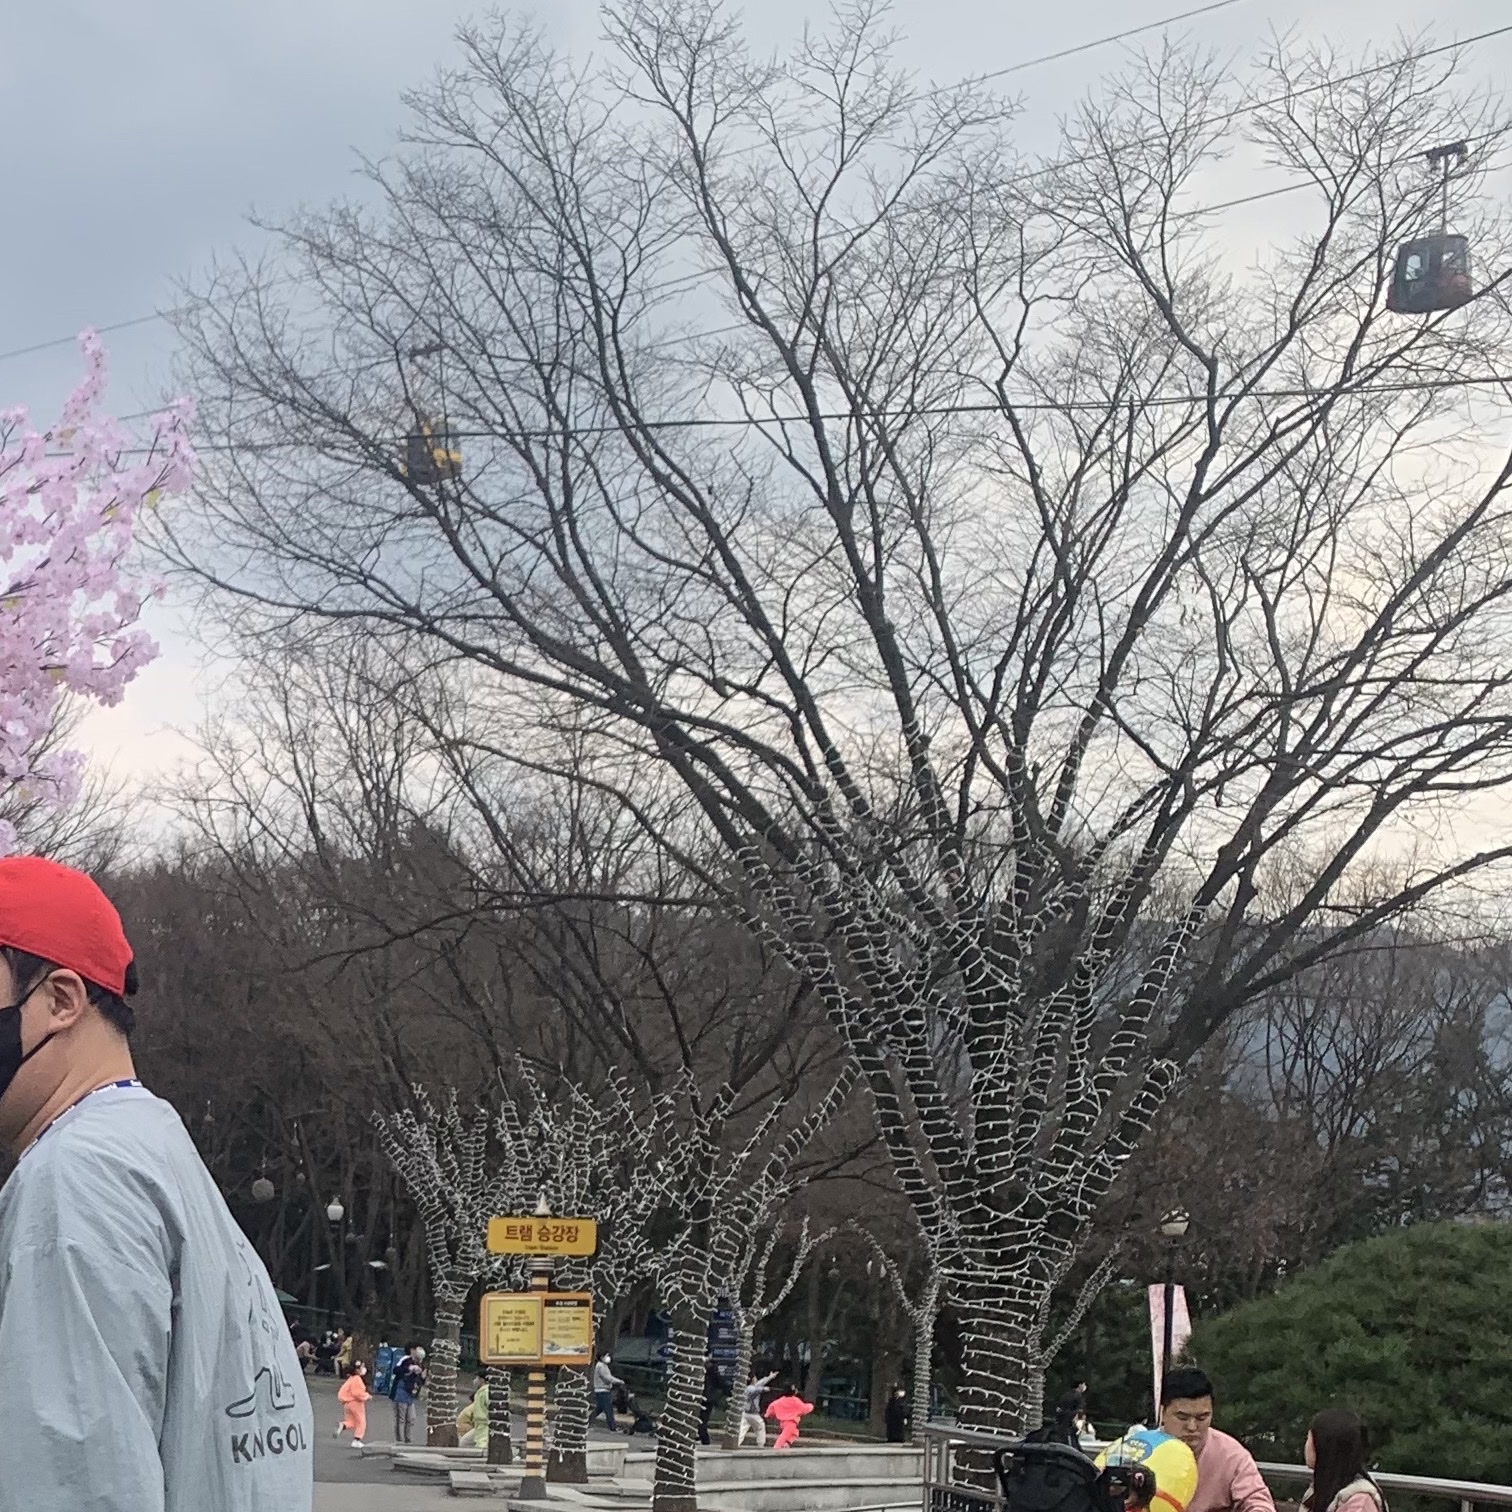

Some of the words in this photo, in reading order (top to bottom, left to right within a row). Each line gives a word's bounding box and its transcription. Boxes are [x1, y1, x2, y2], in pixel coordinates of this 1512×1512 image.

[505, 1225, 533, 1242] 트램
[537, 1225, 579, 1242] 승강장
[231, 1423, 307, 1464] KNGOL
